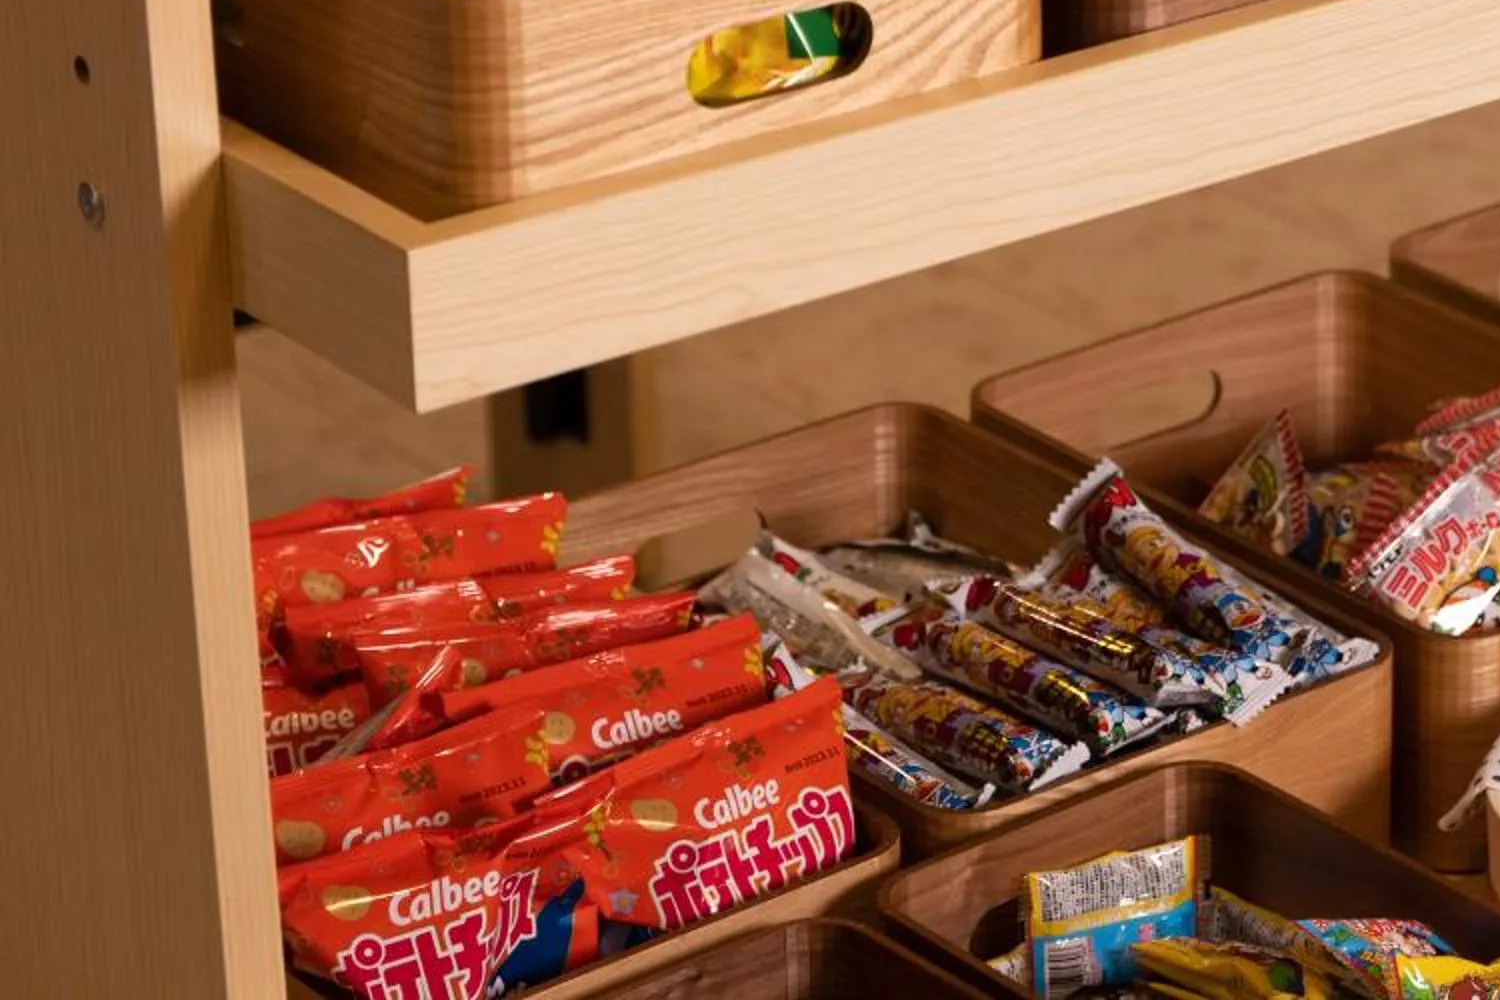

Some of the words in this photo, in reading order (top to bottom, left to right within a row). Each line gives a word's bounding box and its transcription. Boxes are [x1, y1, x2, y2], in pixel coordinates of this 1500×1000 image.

[592, 708, 684, 749] Calbee
[694, 779, 781, 829] Calbee
[388, 870, 501, 926] Calbee
